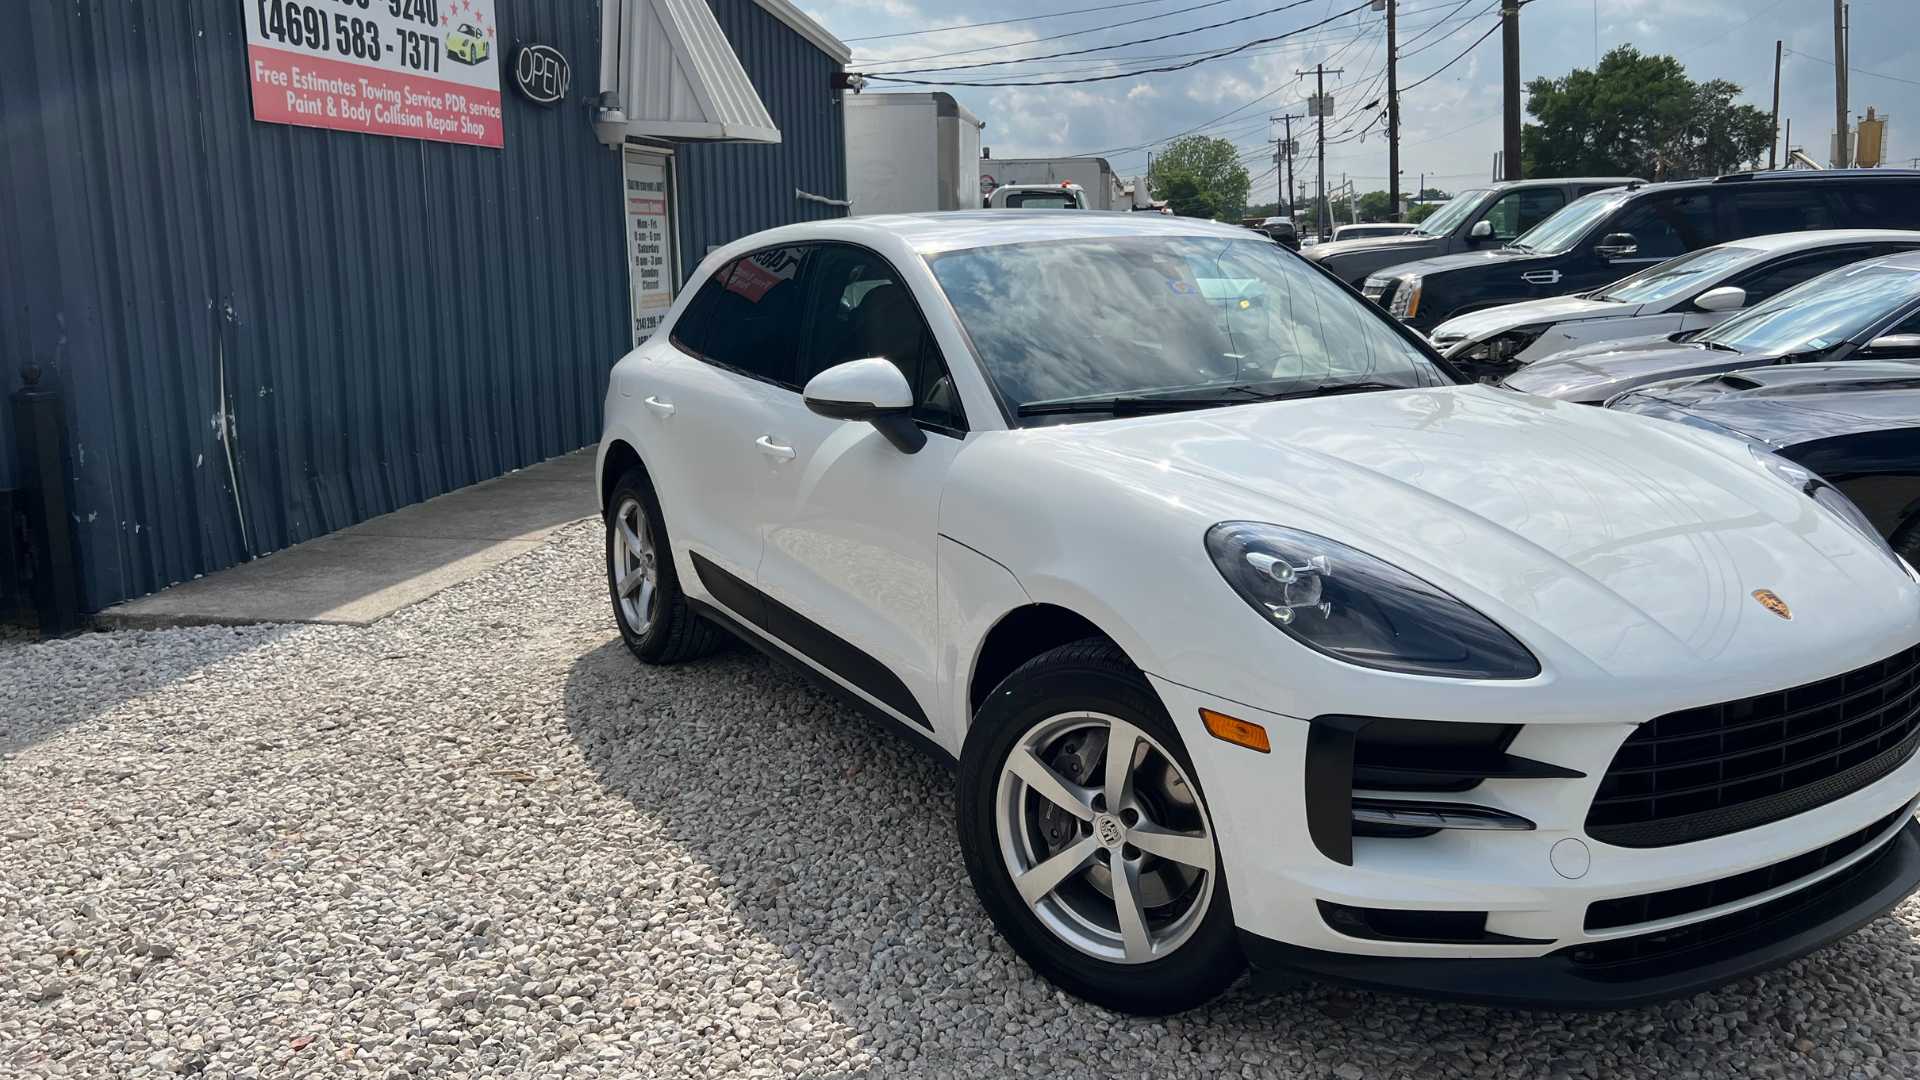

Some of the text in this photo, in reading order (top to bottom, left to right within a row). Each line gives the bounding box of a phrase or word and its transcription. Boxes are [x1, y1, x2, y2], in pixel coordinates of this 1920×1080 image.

[257, 0, 330, 51] (469)
[335, 13, 381, 62] 583
[396, 28, 440, 73] 7377
[254, 60, 501, 119] Free Estimates Towing Service PDR service
[519, 47, 566, 99] OPEN
[286, 91, 485, 139] Paint & Body Collision Repair Shop
[637, 243, 659, 255] Saturday
